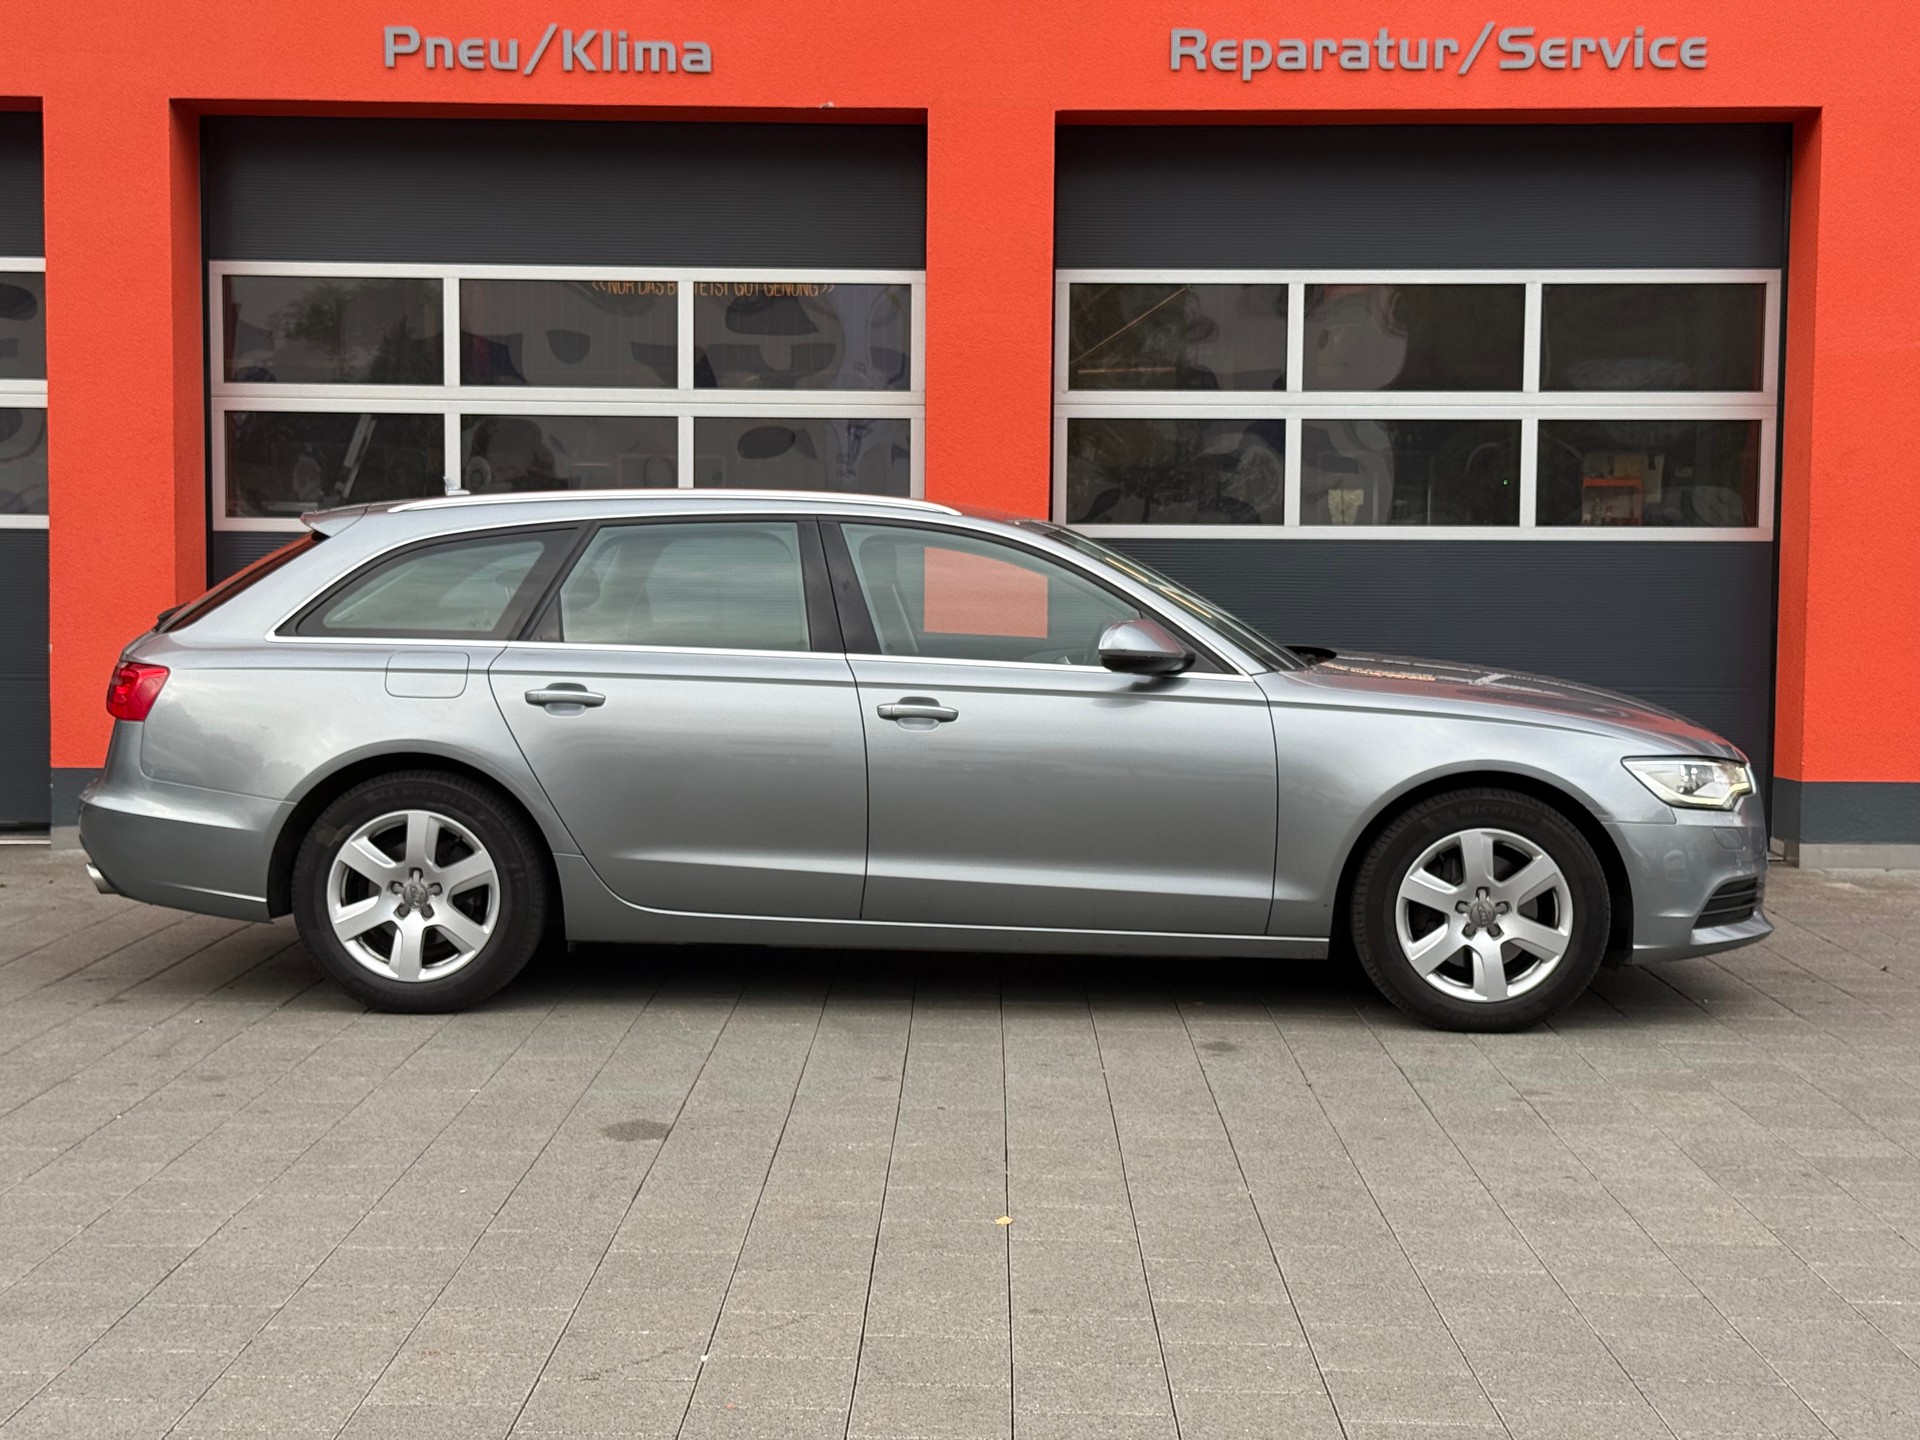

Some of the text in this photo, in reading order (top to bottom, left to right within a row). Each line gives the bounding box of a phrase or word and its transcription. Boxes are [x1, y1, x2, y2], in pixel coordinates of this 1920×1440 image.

[383, 23, 712, 75] Pneu/Klima
[1169, 22, 1708, 82] Reparatur/Service
[1458, 804, 1537, 822] MICHELIN
